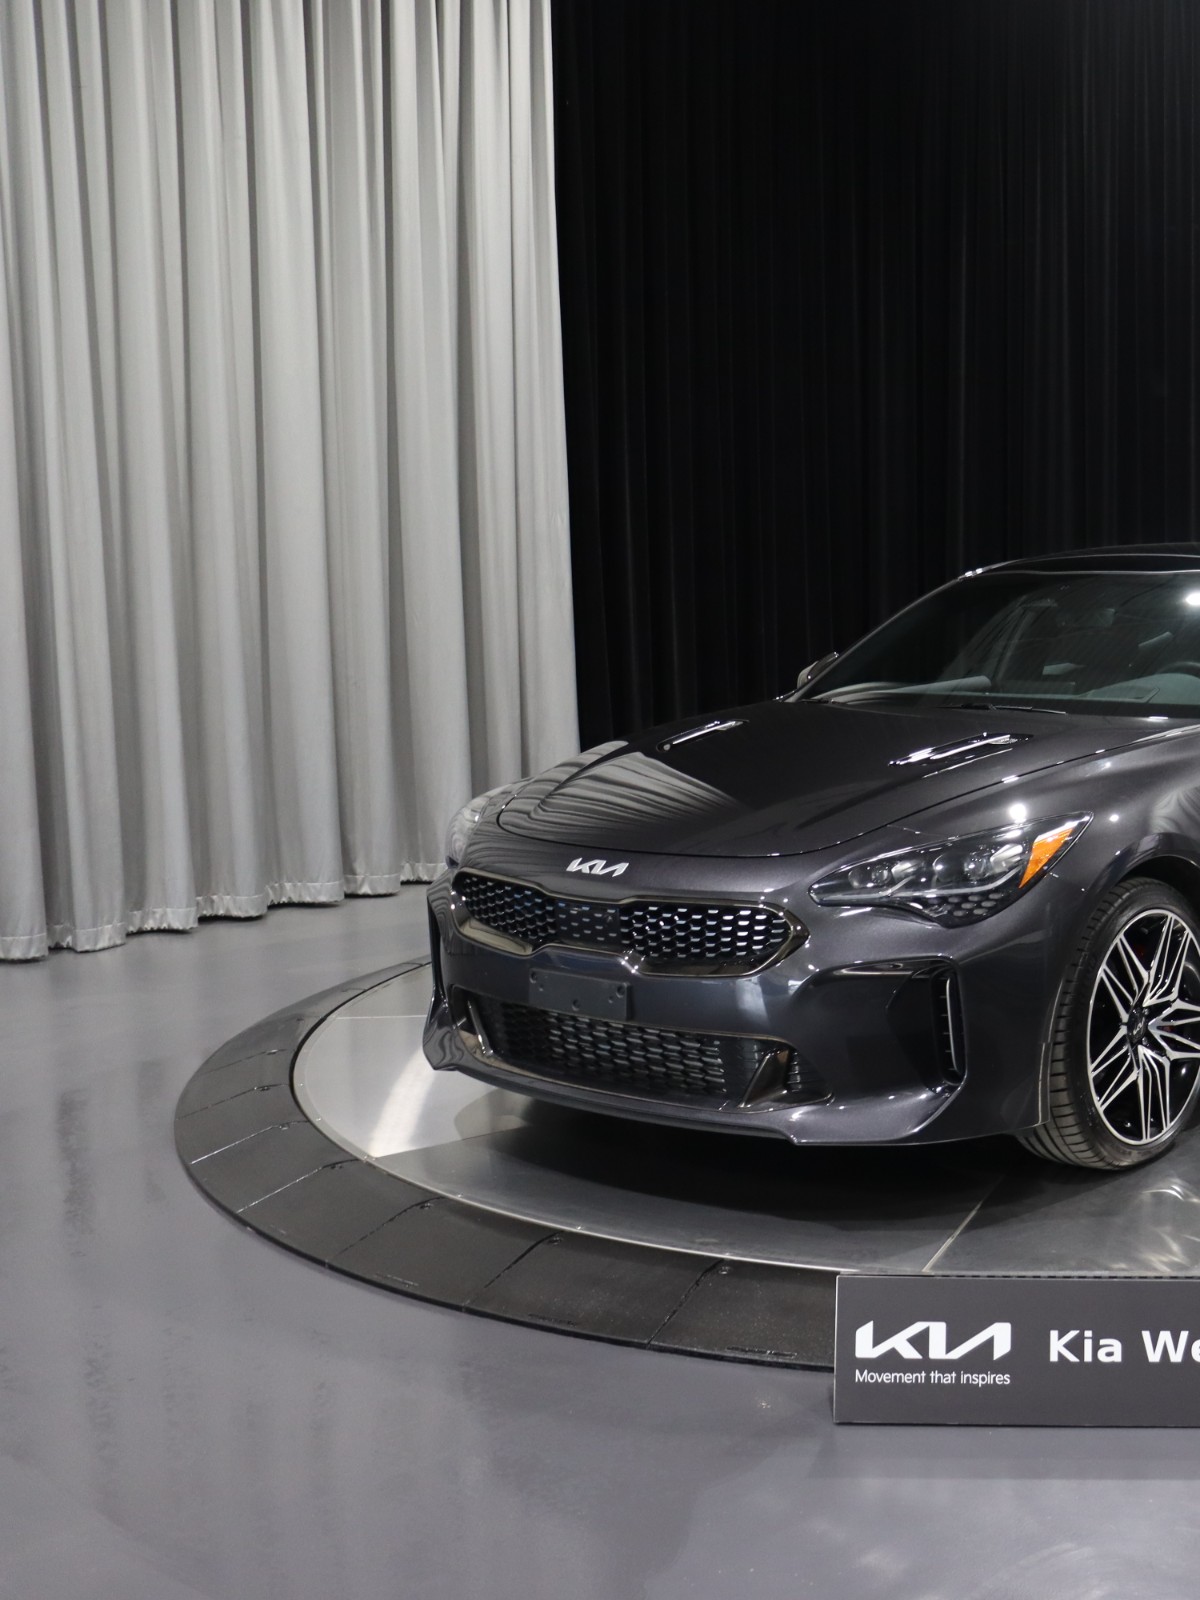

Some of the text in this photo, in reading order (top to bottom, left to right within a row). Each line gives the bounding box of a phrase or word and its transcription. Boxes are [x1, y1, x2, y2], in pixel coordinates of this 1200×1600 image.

[566, 857, 630, 878] KIA
[855, 1320, 1011, 1361] KIA
[1050, 1329, 1123, 1363] Kia
[855, 1368, 1011, 1388] Movement that inspires
